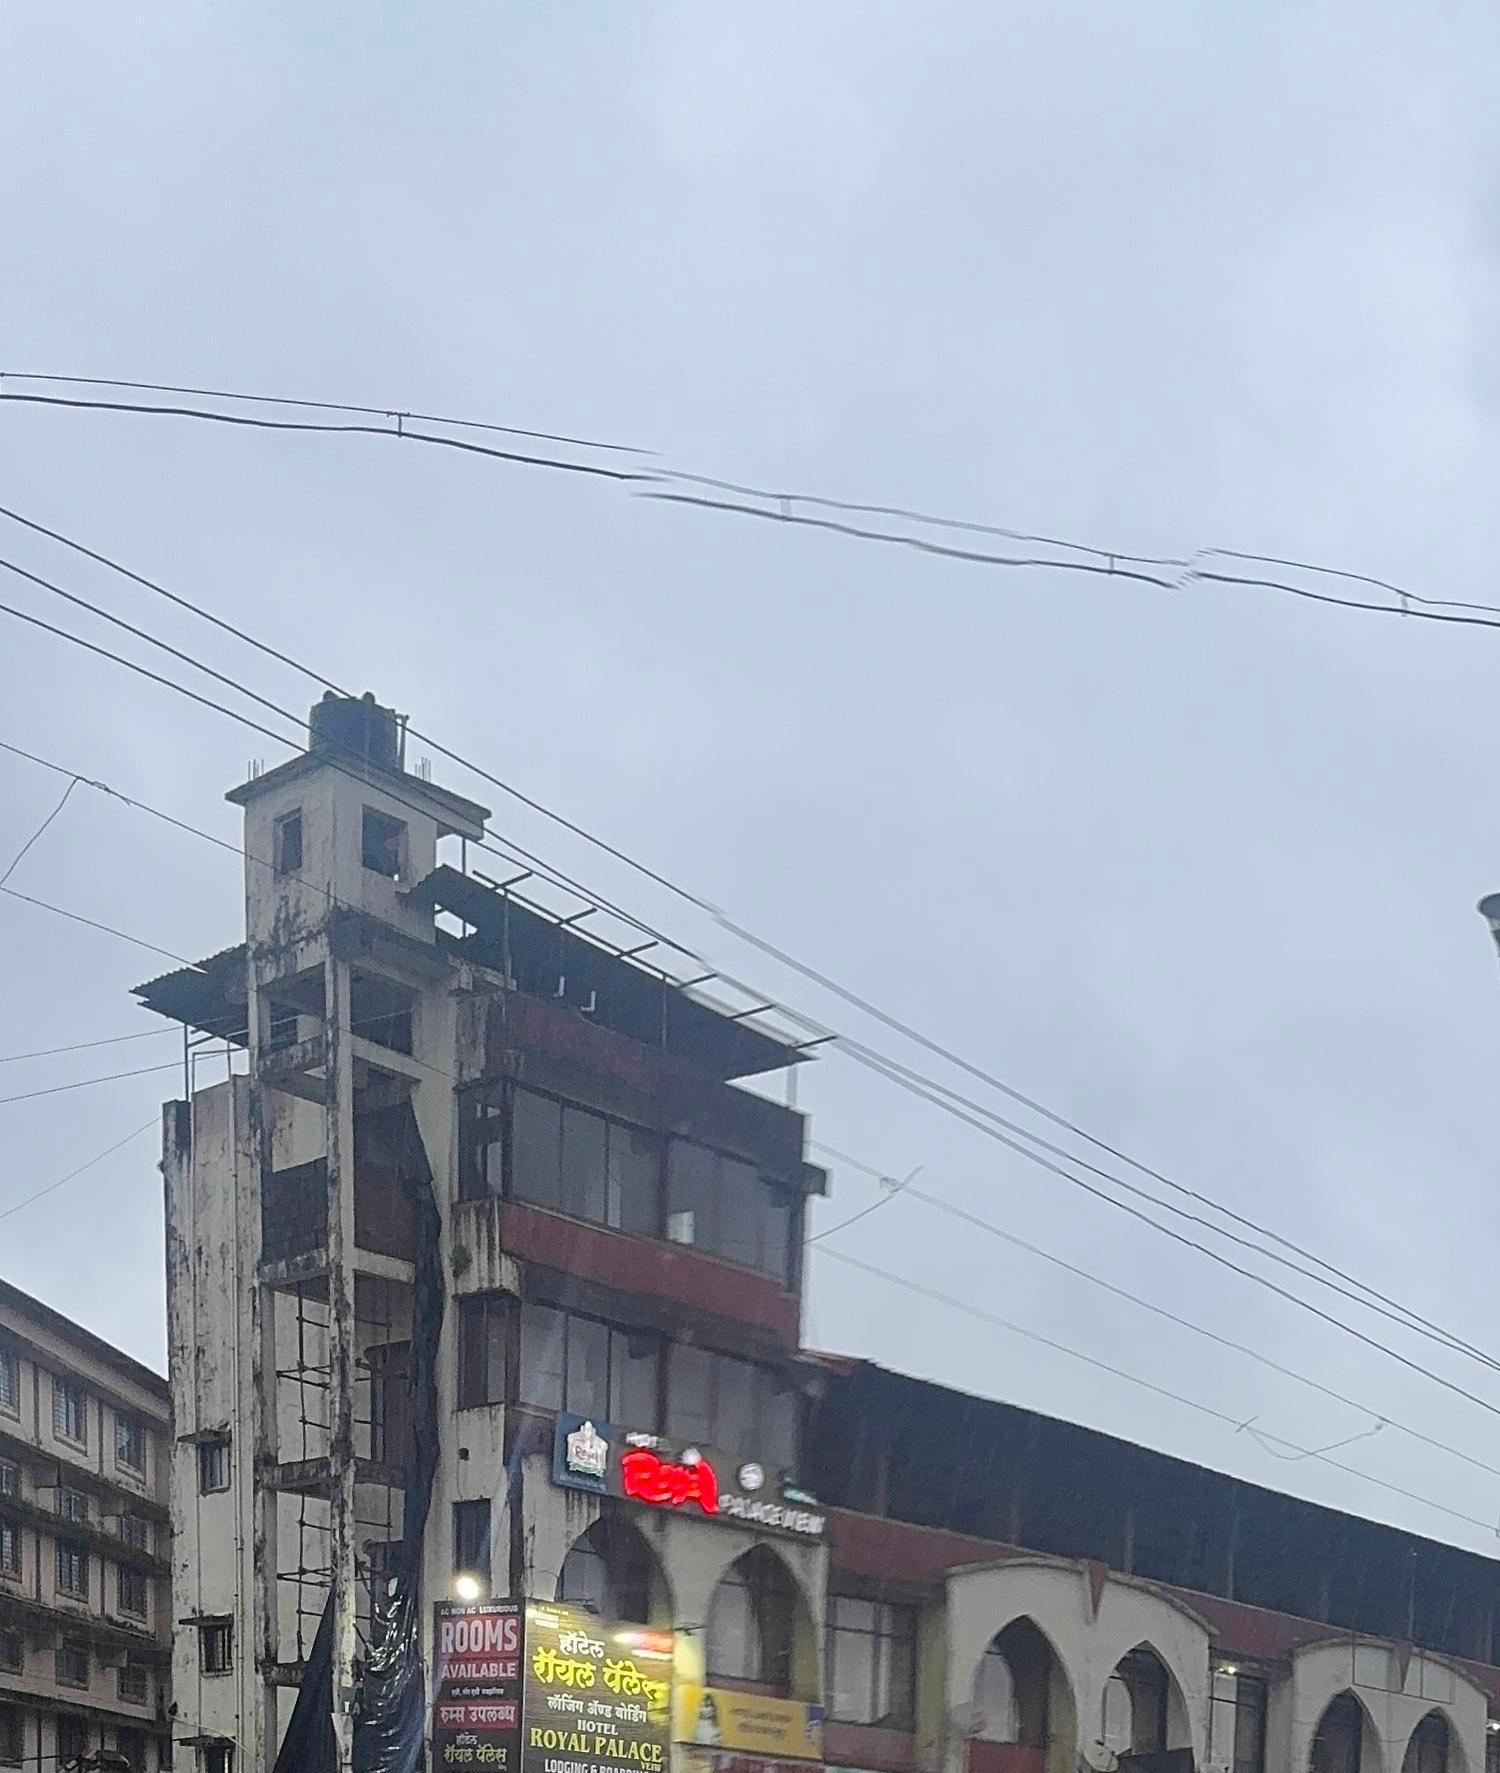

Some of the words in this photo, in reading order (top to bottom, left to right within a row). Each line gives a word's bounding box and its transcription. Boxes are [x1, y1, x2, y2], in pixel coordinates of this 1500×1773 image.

[441, 1619, 518, 1653] ROOMS
[558, 1631, 605, 1658] हॉटेल
[441, 1663, 516, 1679] AVAILABLE
[532, 1646, 597, 1688] रॉयल
[547, 1694, 584, 1713] लॉजिंग
[577, 1720, 619, 1735] HOTEL
[530, 1727, 591, 1753] ROYAL
[594, 1736, 663, 1763] PALACE
